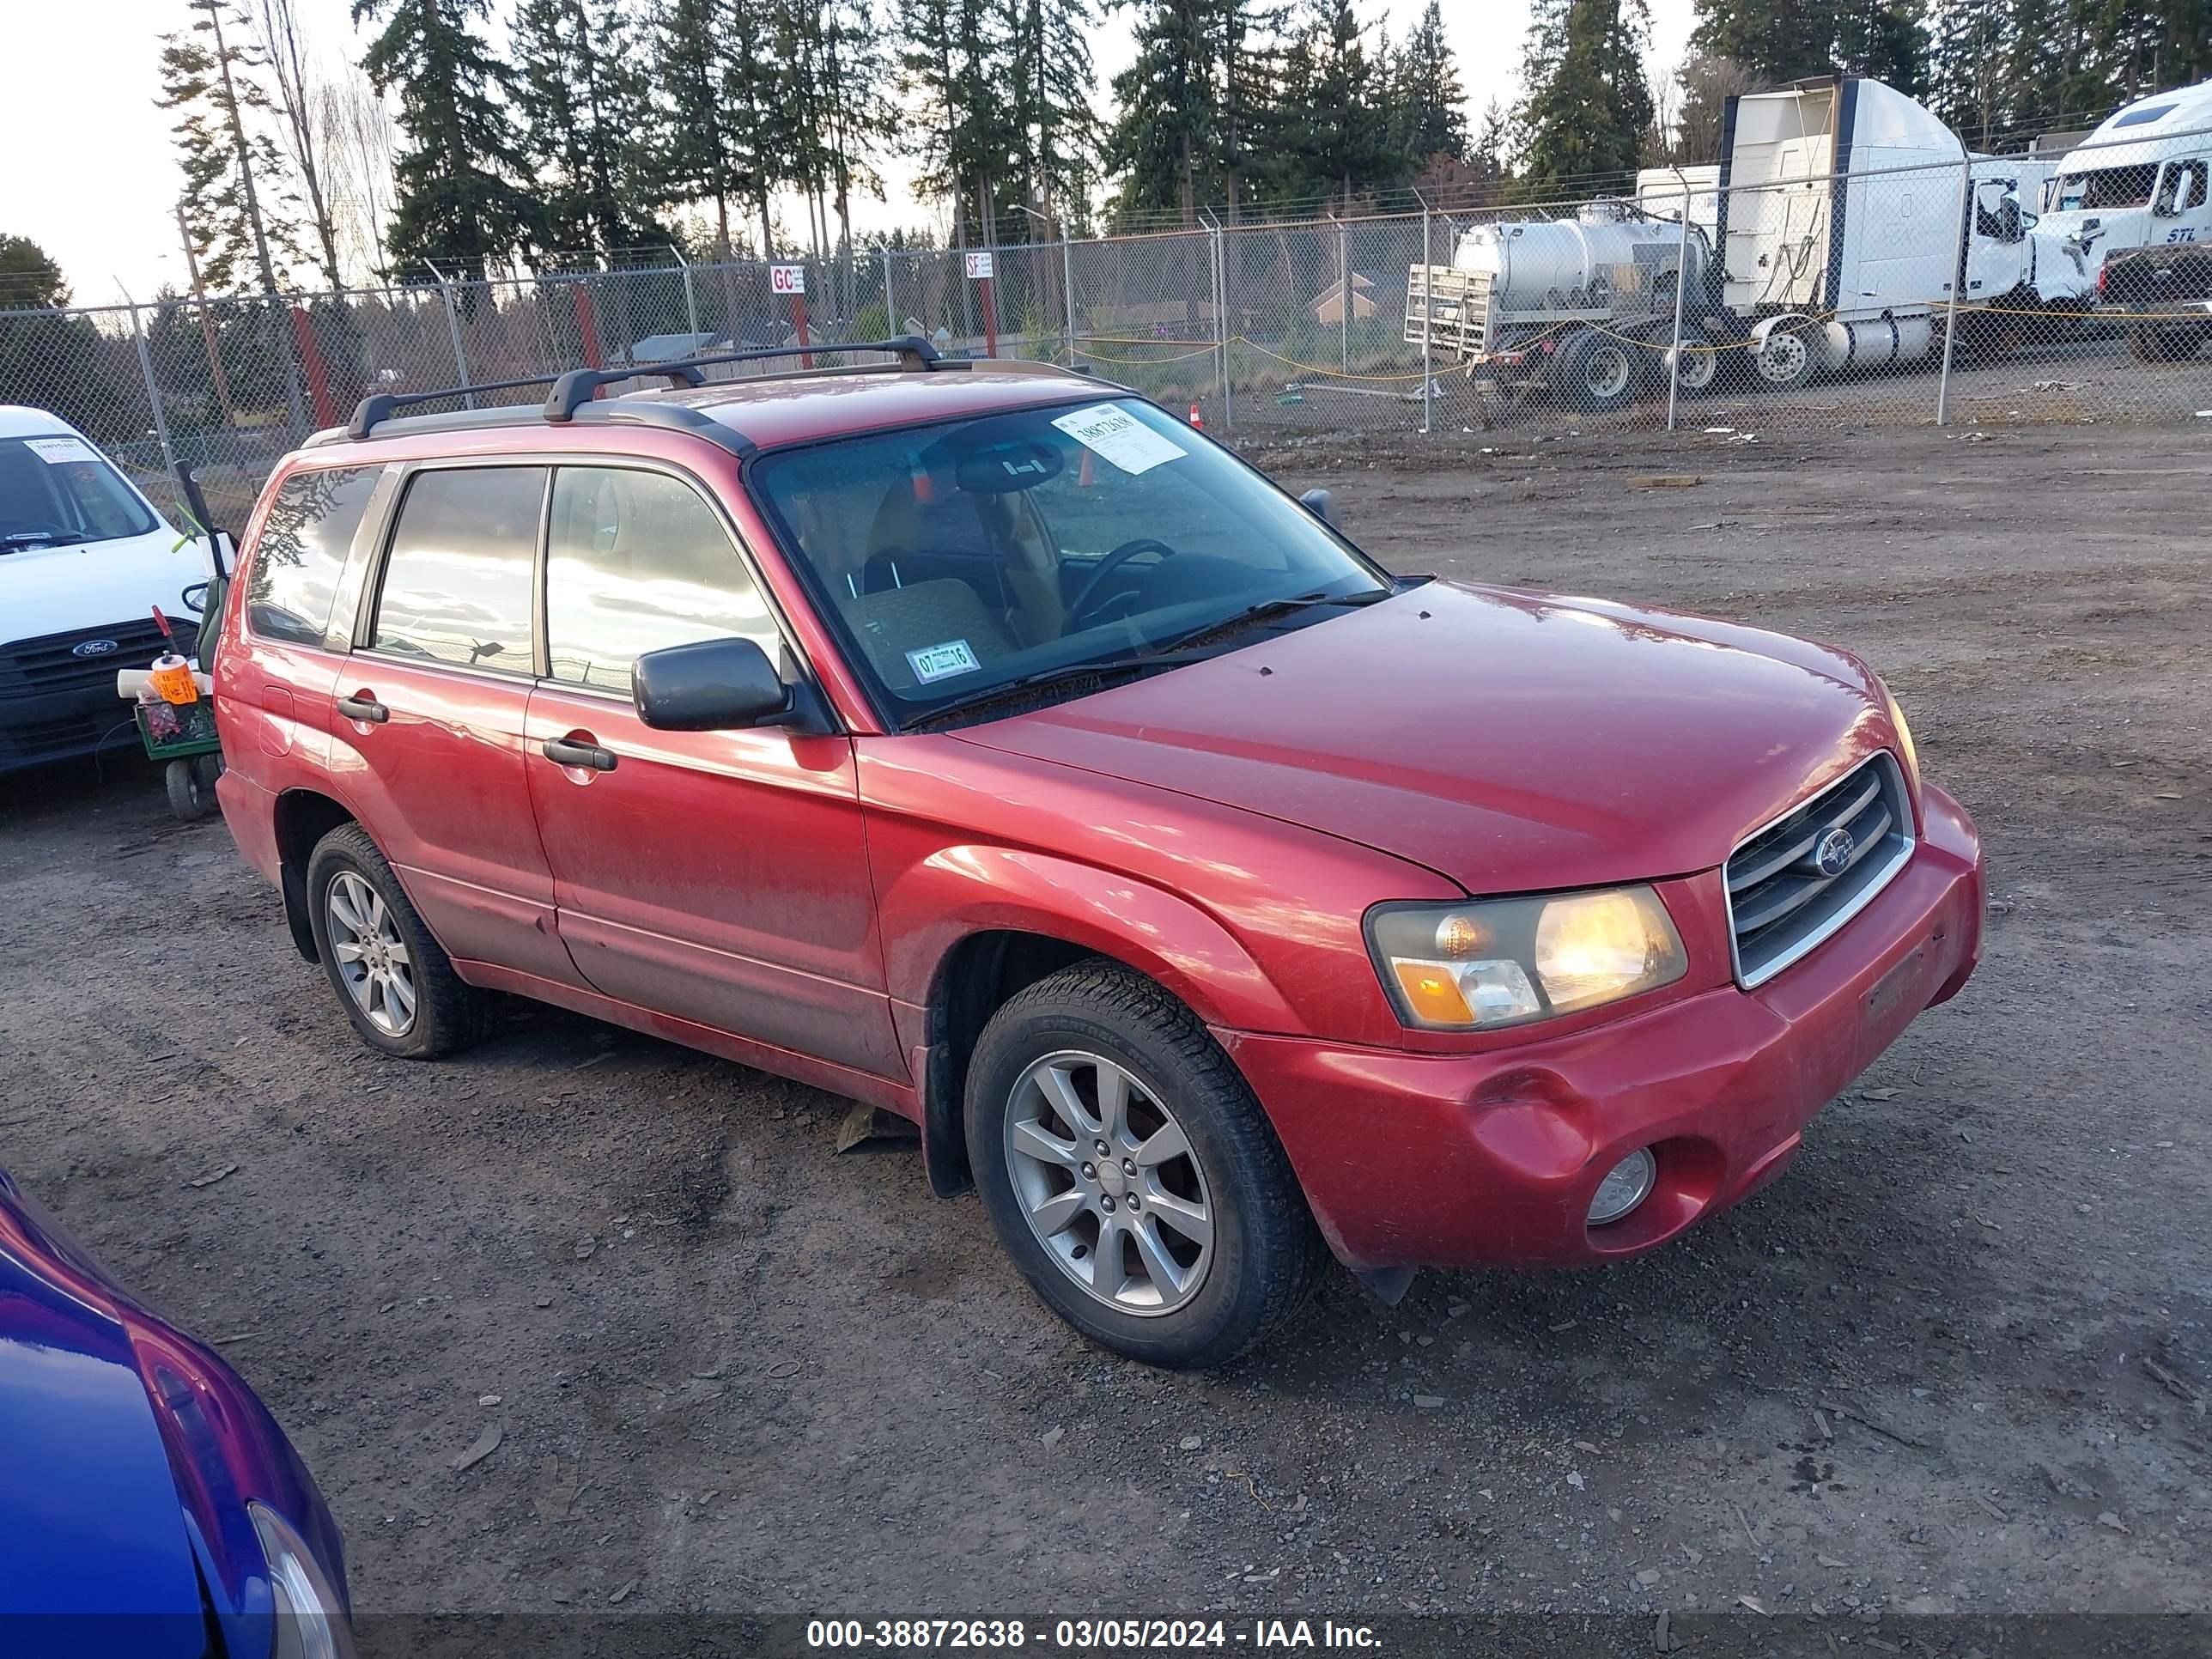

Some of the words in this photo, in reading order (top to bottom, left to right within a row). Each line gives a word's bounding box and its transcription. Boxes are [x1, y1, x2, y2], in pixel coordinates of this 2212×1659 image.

[968, 255, 979, 276] SF
[774, 269, 793, 289] GC
[1077, 416, 1134, 441] 38872638
[84, 642, 108, 653] Ford
[919, 655, 934, 673] 07
[950, 647, 967, 666] 16
[1042, 1018, 1121, 1047] EVERTREK
